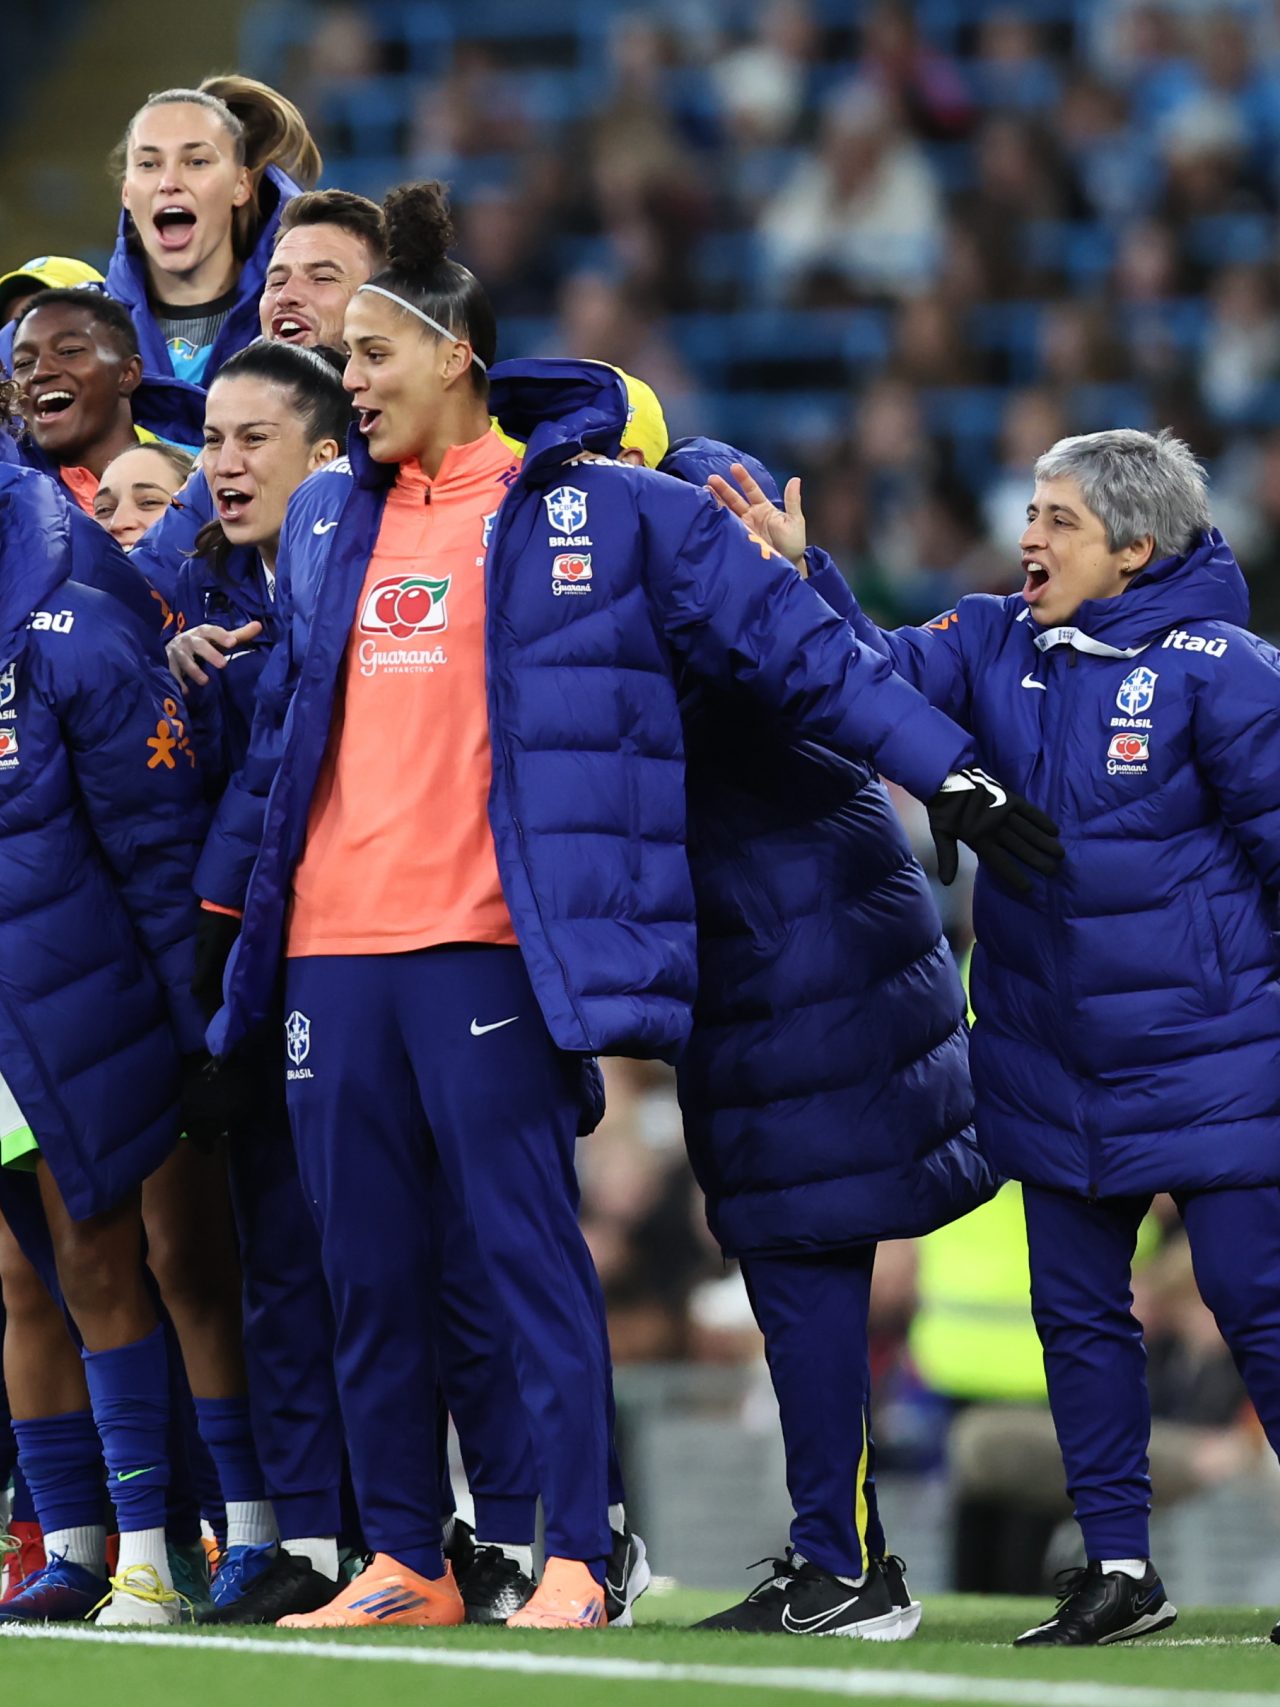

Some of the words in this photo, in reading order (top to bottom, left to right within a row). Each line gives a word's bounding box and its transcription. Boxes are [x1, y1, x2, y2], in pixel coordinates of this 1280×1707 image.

[549, 536, 593, 547] BRASIL
[552, 579, 592, 596] Guaraná
[358, 639, 448, 677] Guaraná
[384, 665, 434, 674] ANTARCTICA
[1110, 717, 1153, 729] BRASIL
[1106, 758, 1149, 776] Guaraná
[287, 1067, 314, 1081] BRASIL
